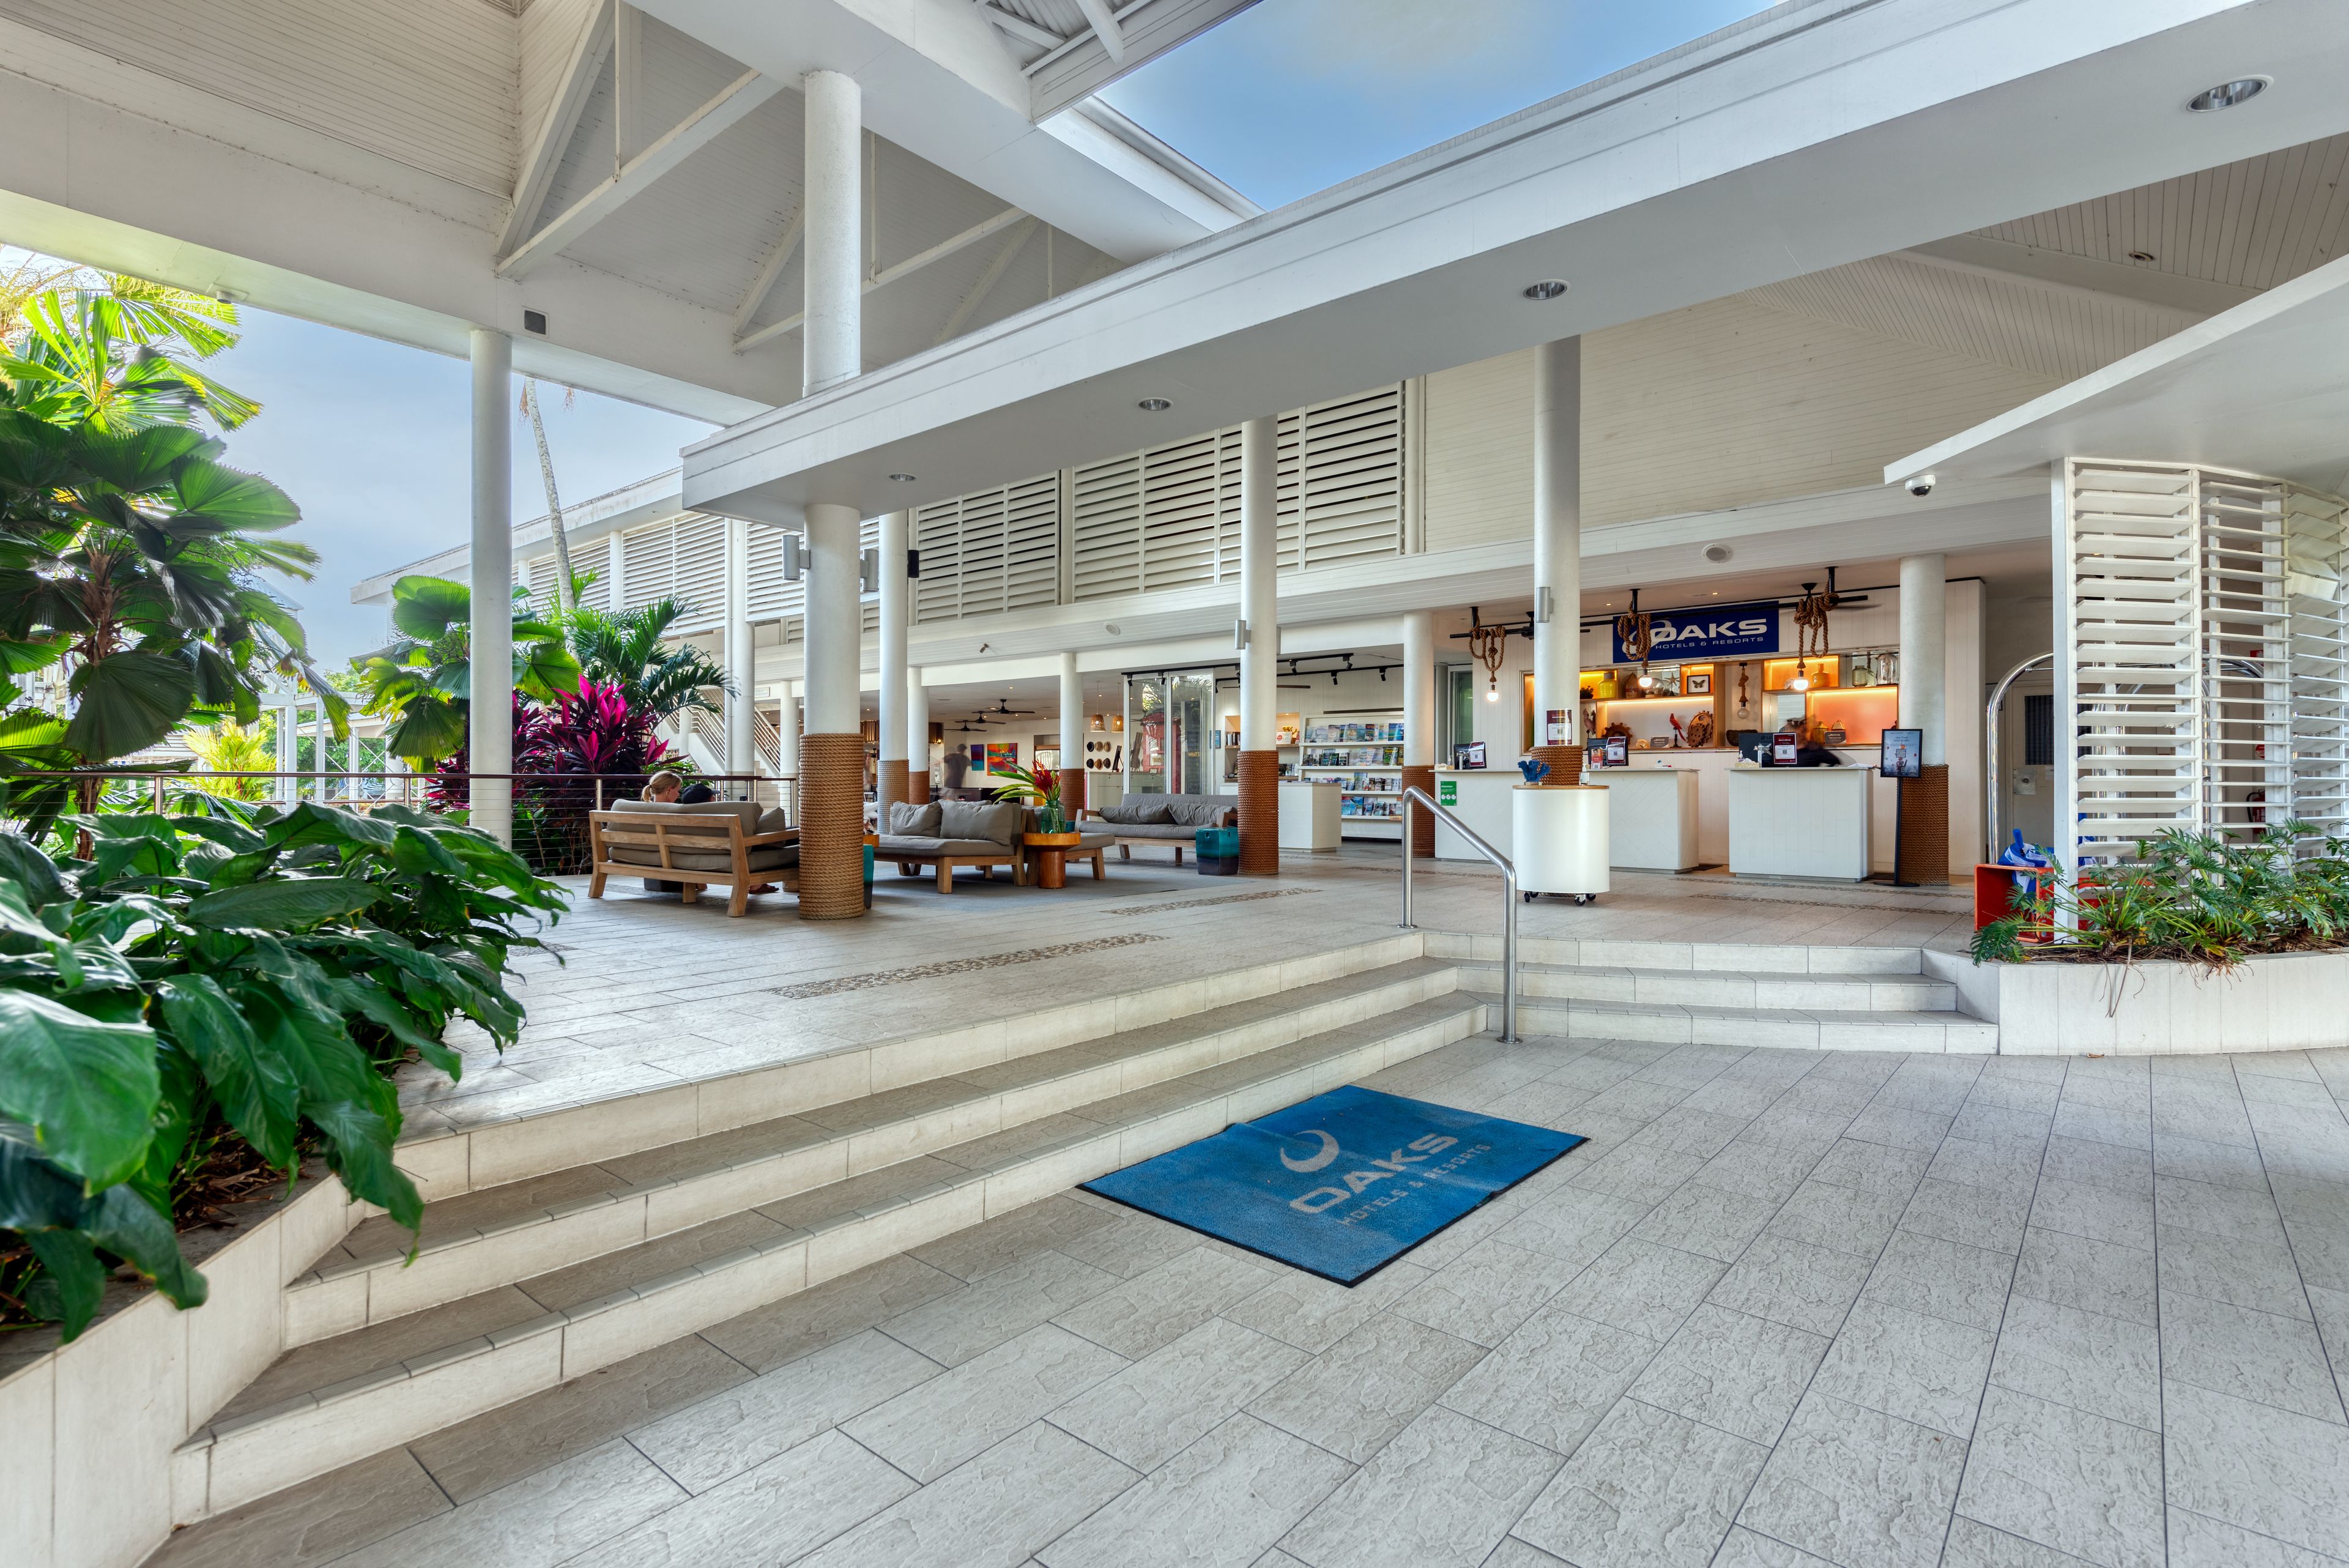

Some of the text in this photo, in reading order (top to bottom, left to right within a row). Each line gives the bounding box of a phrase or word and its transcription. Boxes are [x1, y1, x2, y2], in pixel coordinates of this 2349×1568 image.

[1649, 619, 1767, 642] OAKS
[1712, 637, 1764, 645] RESORTS
[1289, 1133, 1458, 1214] OAKS
[1335, 1189, 1408, 1225] HOTELS
